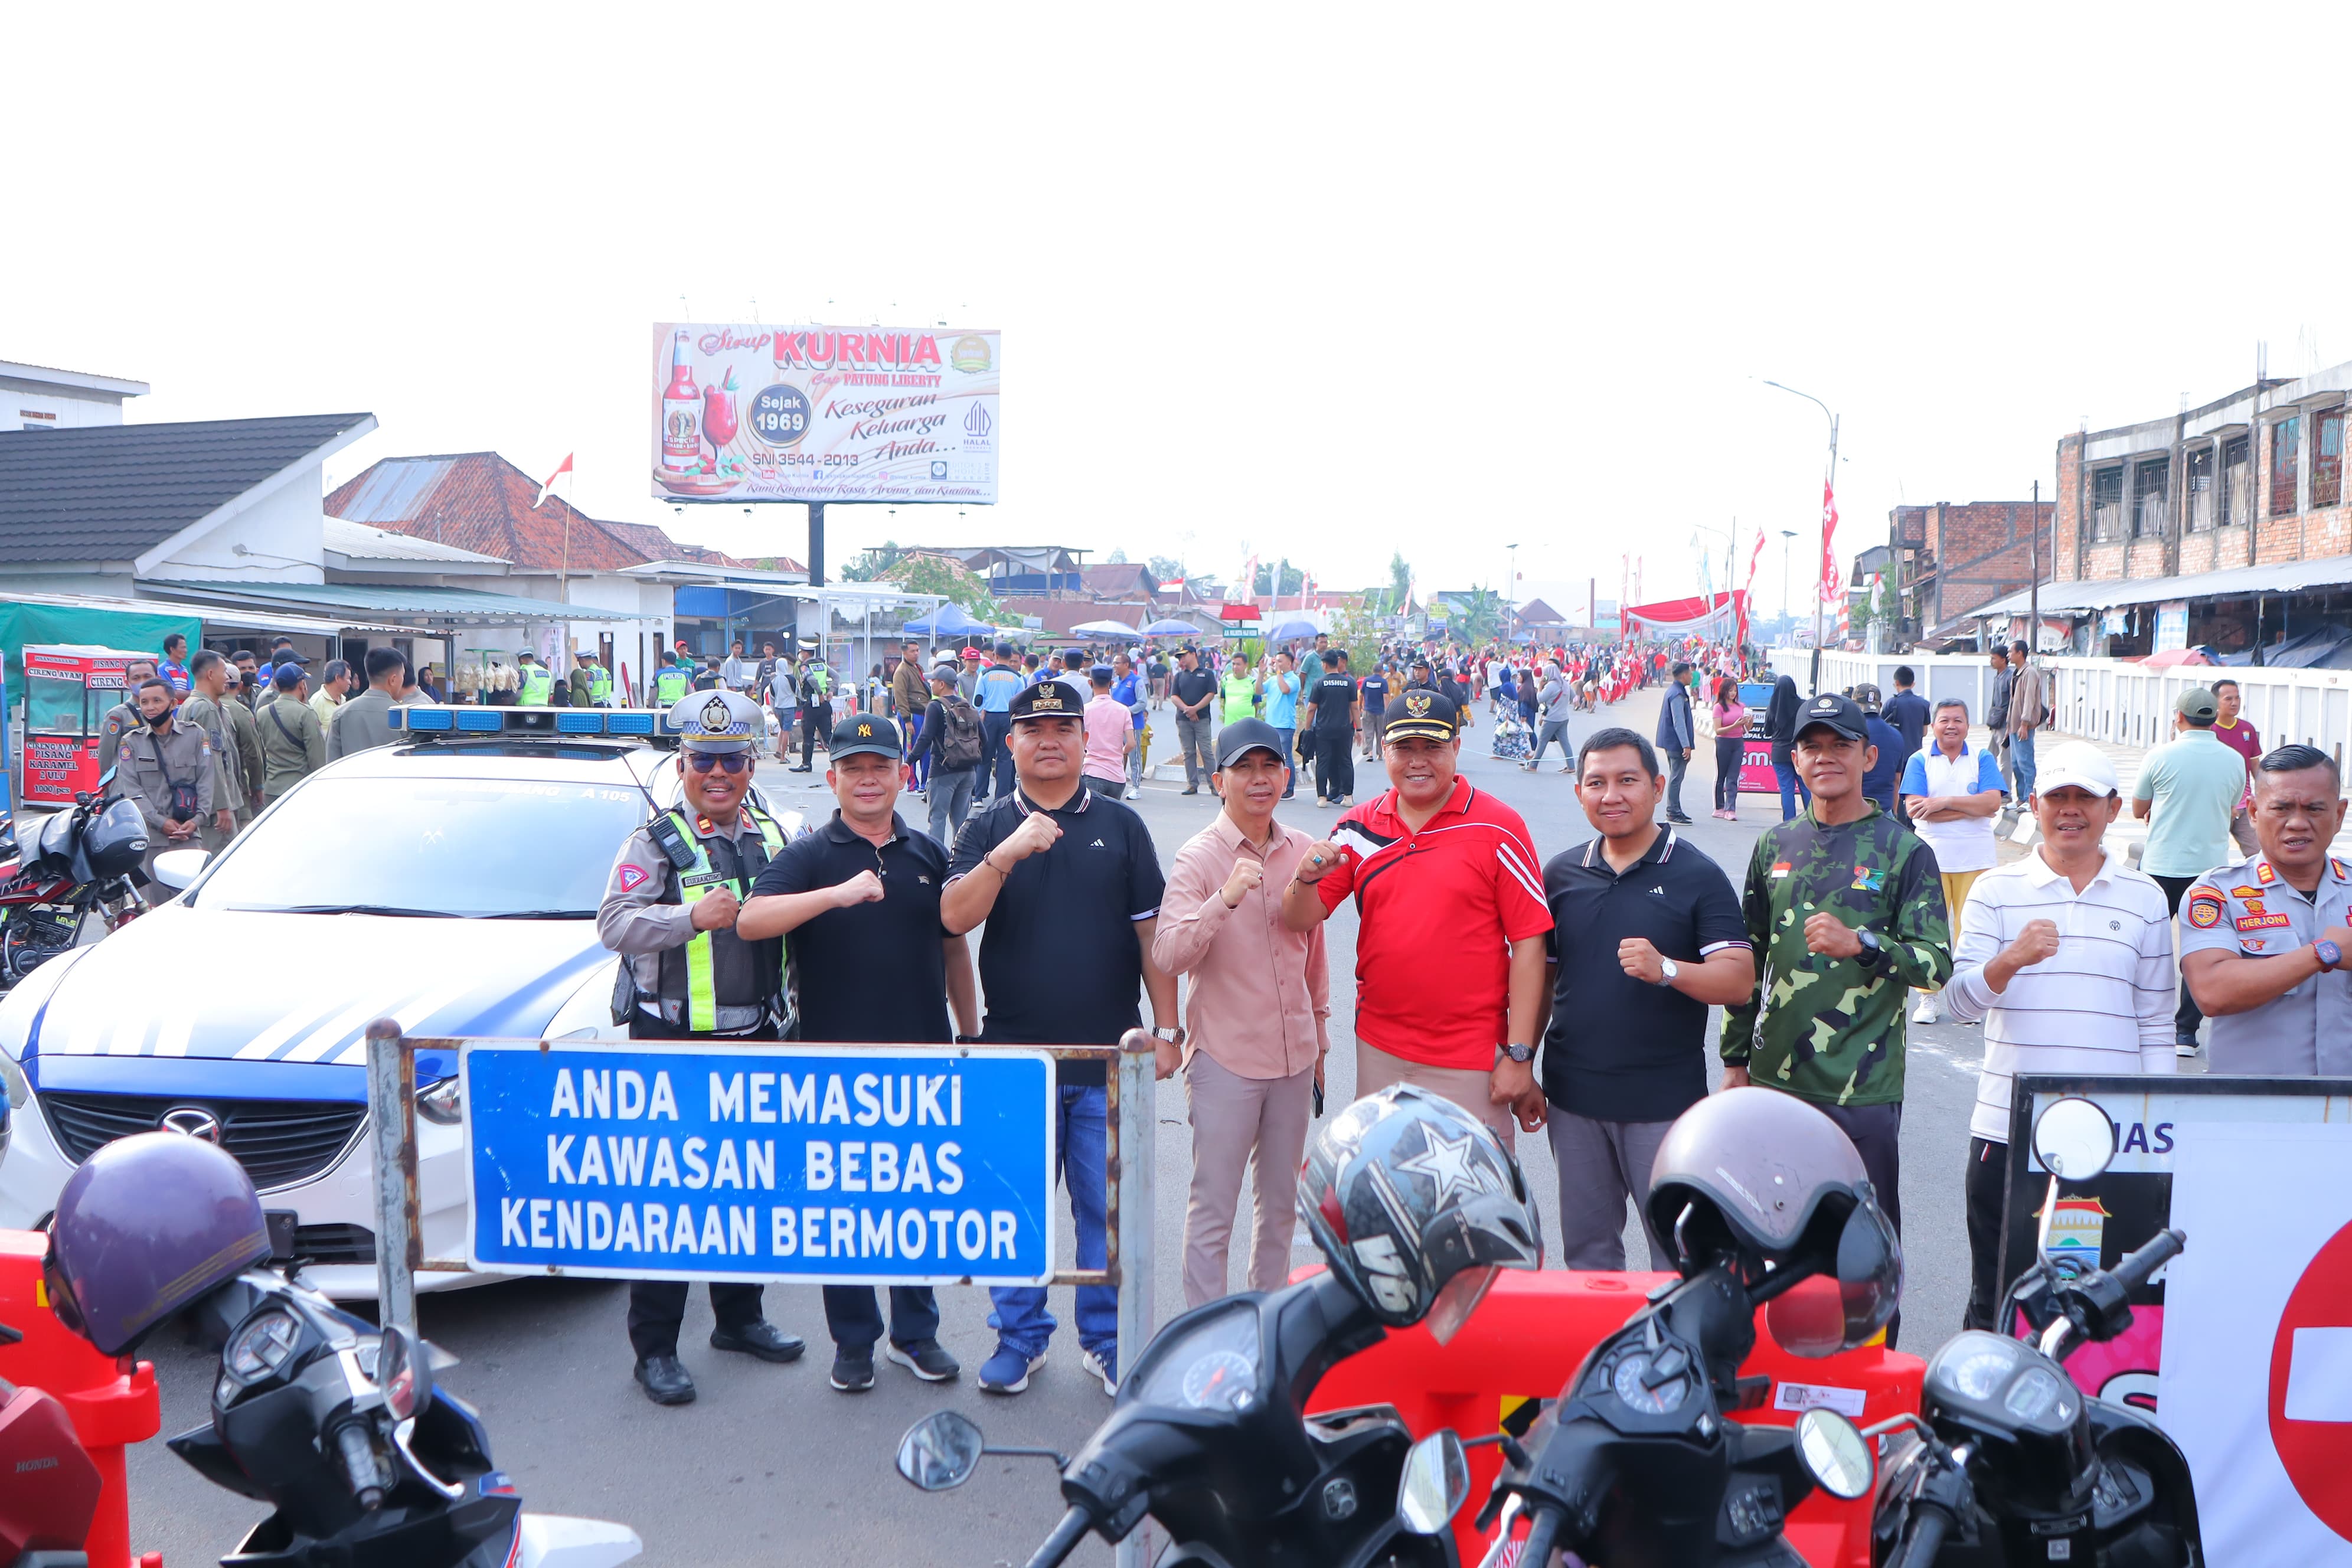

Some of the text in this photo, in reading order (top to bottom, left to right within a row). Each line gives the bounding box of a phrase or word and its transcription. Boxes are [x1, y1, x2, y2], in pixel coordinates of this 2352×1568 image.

[698, 328, 943, 373] Sirup KURNIA
[843, 373, 888, 387] PATUNG
[891, 374, 942, 388] LIBERTY
[761, 396, 801, 413] Sejak
[756, 413, 805, 432] 1969
[850, 414, 946, 440] Keluarga
[753, 453, 775, 465] SNI
[778, 454, 815, 466] 3544
[824, 454, 859, 466] 2013
[93, 659, 120, 669] PISANG
[28, 668, 82, 680] CIRENG AYAM
[90, 677, 123, 687] CIRENG
[27, 742, 56, 750] CIRENG
[35, 750, 72, 759] PISANG
[30, 760, 78, 770] KARAMEL
[48, 771, 67, 780] ULU
[34, 785, 71, 795] 1000/pcs
[580, 788, 596, 799] A
[600, 789, 631, 802] 105
[2239, 916, 2287, 929] HERJONI
[550, 1069, 962, 1127] ANDA MEMASUKI
[547, 1134, 963, 1195] KAWASAN BEBAS
[501, 1197, 1017, 1260] KENDARAAN BERMOTOR
[15, 1456, 58, 1474] HONDA
